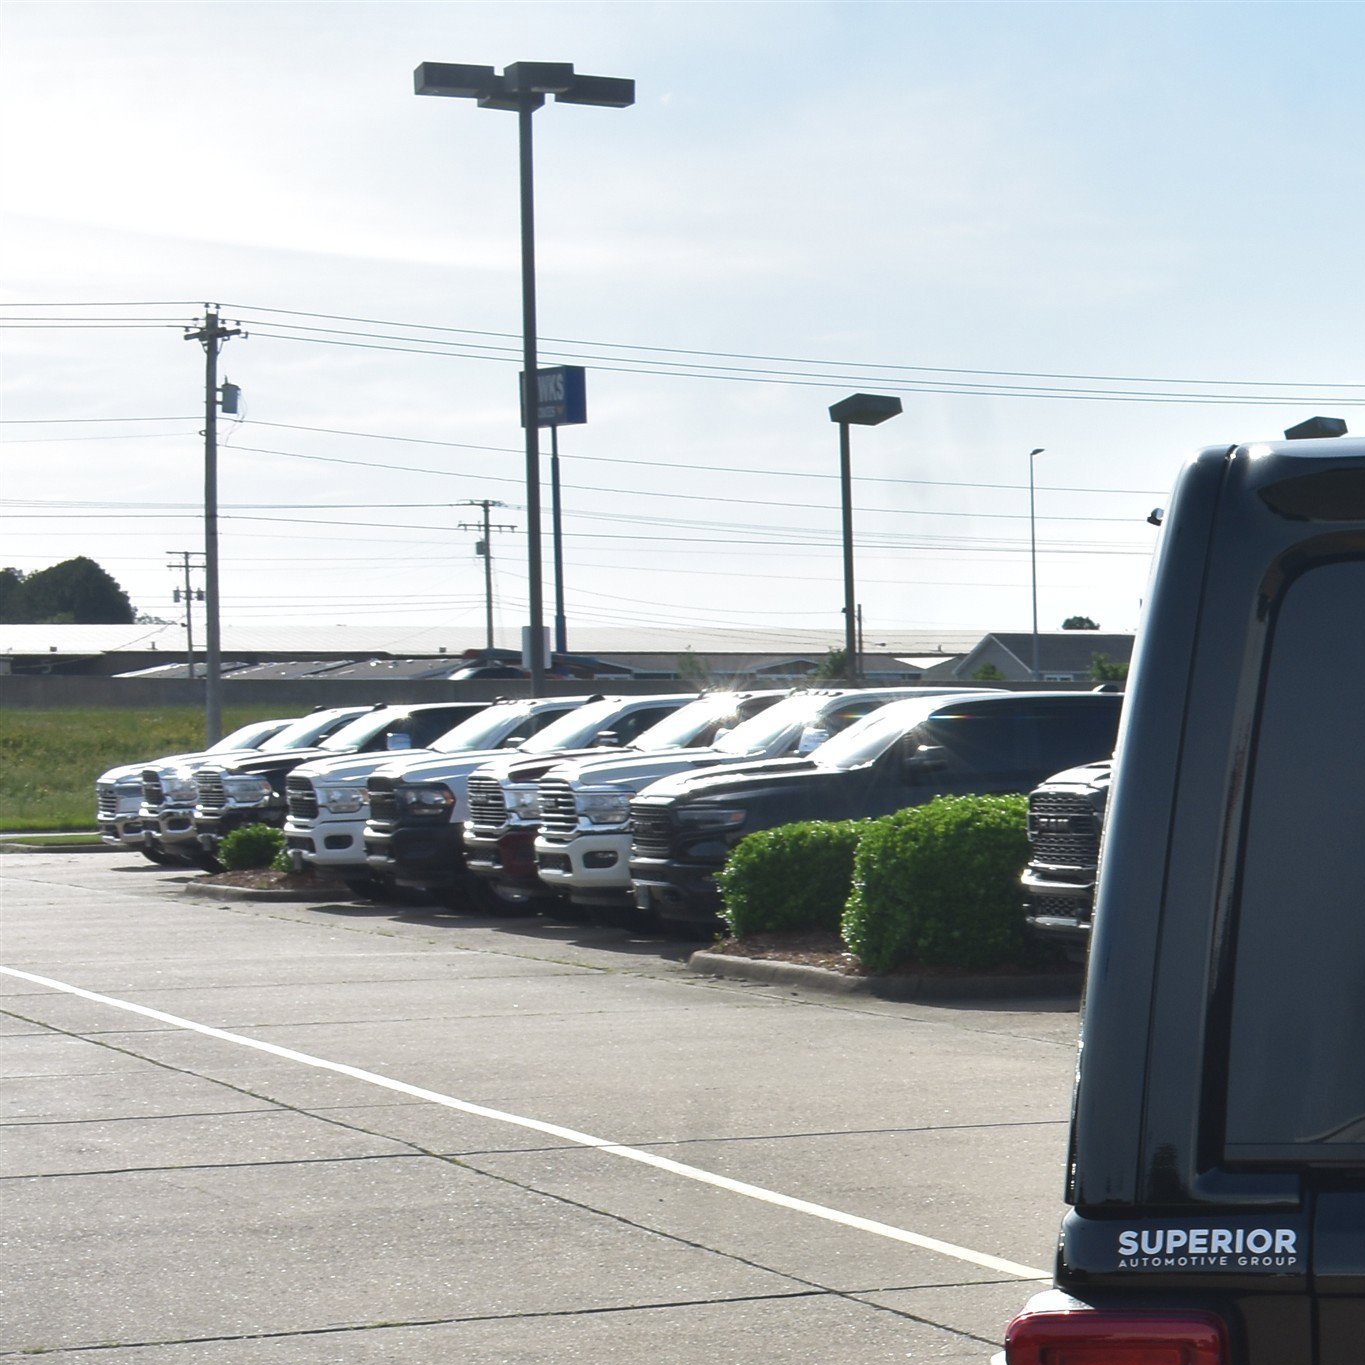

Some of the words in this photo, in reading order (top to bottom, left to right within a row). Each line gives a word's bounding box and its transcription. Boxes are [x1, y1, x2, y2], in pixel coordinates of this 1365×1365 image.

[1118, 1228, 1297, 1256] SUPERIOR
[1118, 1256, 1228, 1268] AUTOMOTIVE
[1237, 1256, 1297, 1266] GROUP
